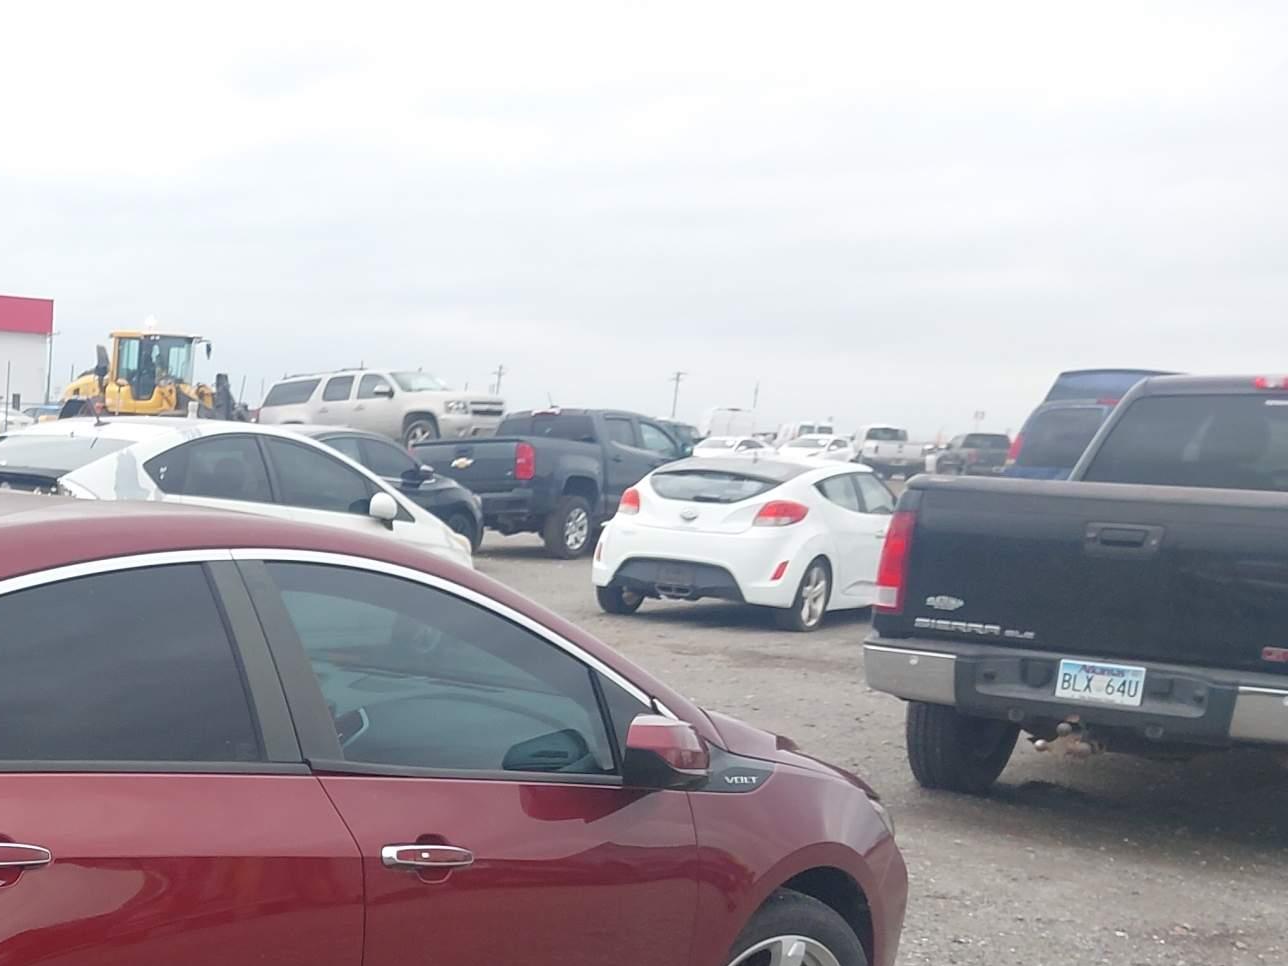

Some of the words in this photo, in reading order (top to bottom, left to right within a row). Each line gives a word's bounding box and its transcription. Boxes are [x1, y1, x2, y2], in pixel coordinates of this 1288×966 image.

[914, 617, 1001, 636] SIERRA
[1061, 672, 1094, 693] BLX
[1105, 678, 1139, 698] 64U
[724, 775, 759, 785] VOLT
